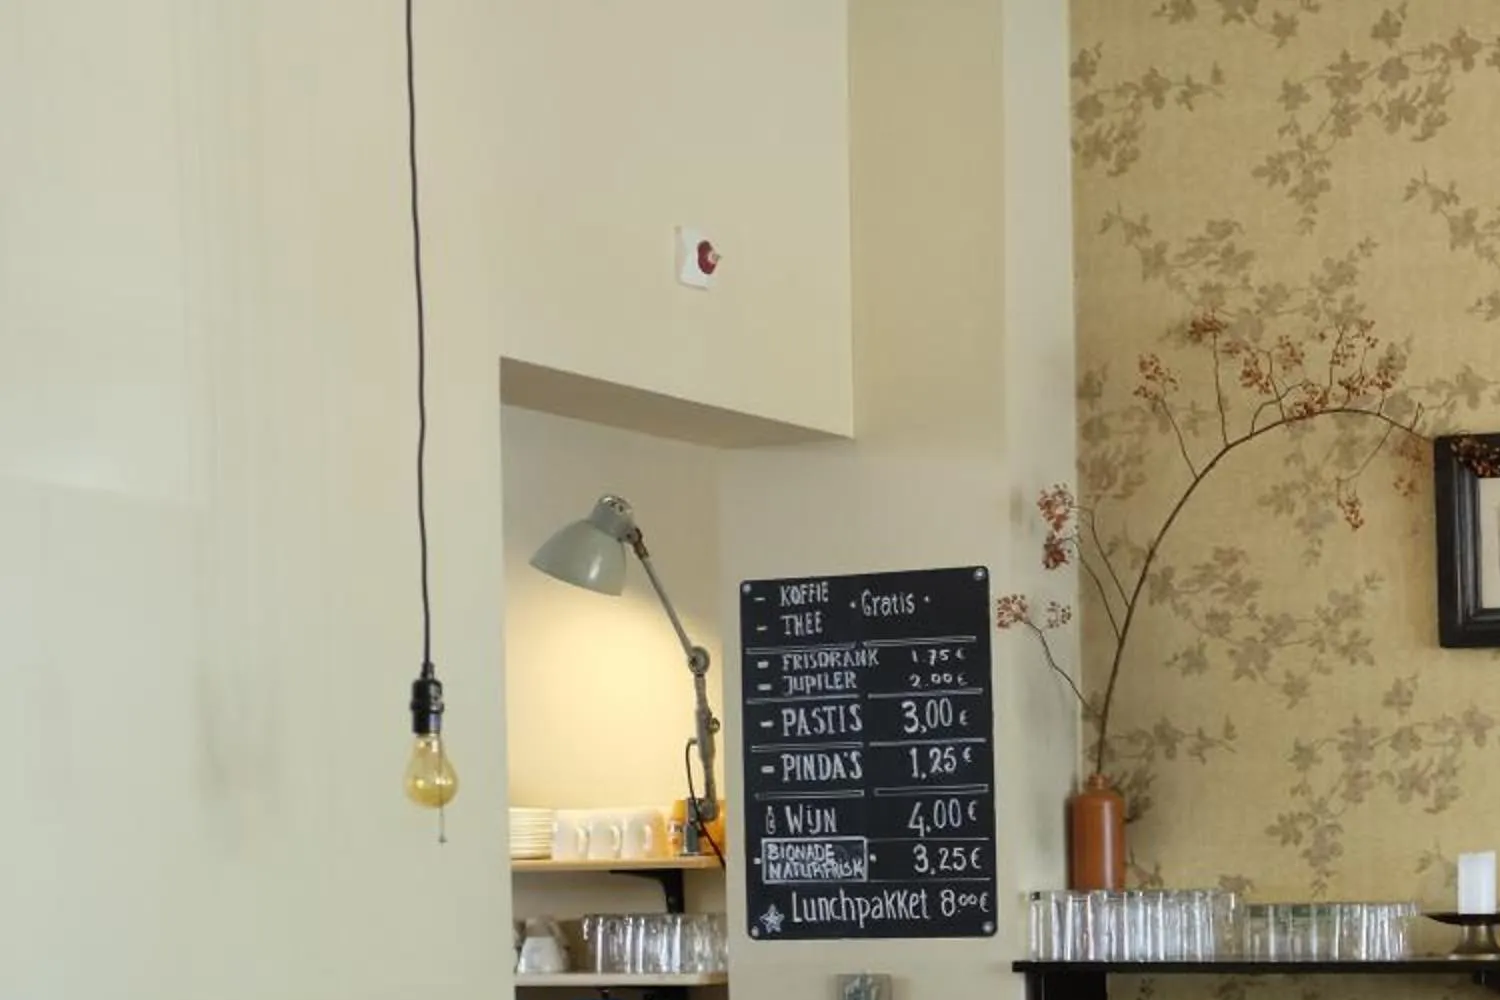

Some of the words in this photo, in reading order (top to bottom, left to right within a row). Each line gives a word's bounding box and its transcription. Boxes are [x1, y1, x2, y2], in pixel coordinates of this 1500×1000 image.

[780, 581, 829, 607] KOFFIE
[861, 588, 916, 617] Gratis
[780, 611, 823, 636] THEE
[782, 648, 879, 671] FRISDRANK
[783, 670, 857, 695] JUPILER
[781, 704, 863, 736] PASTIS
[780, 750, 863, 783] PINDA'S
[791, 888, 931, 928] Lunchpakket
